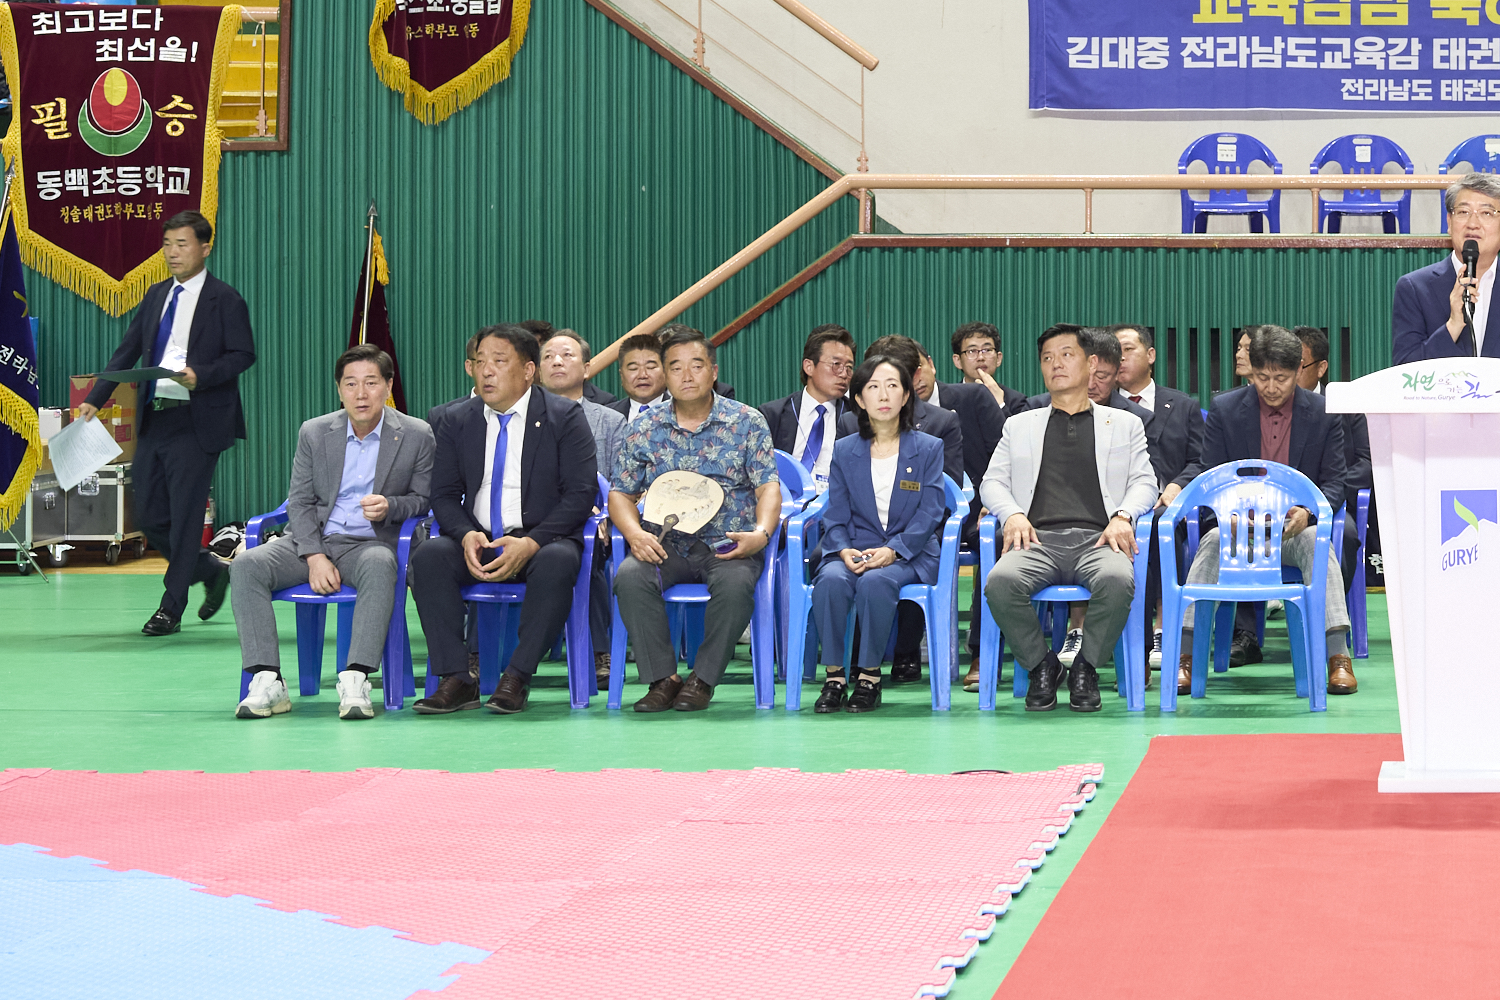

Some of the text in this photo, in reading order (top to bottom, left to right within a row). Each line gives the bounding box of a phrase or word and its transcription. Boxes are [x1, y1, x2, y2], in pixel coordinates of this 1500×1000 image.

[31, 8, 164, 36] 최고보다
[95, 36, 199, 63] 최선을!
[1066, 36, 1170, 70] 김대중
[1180, 36, 1421, 71] 전라남도교육감
[1340, 79, 1433, 102] 전라남도
[31, 94, 197, 140] 필 승
[36, 165, 191, 201] 동백초등학교
[1442, 543, 1479, 571] GURYE
